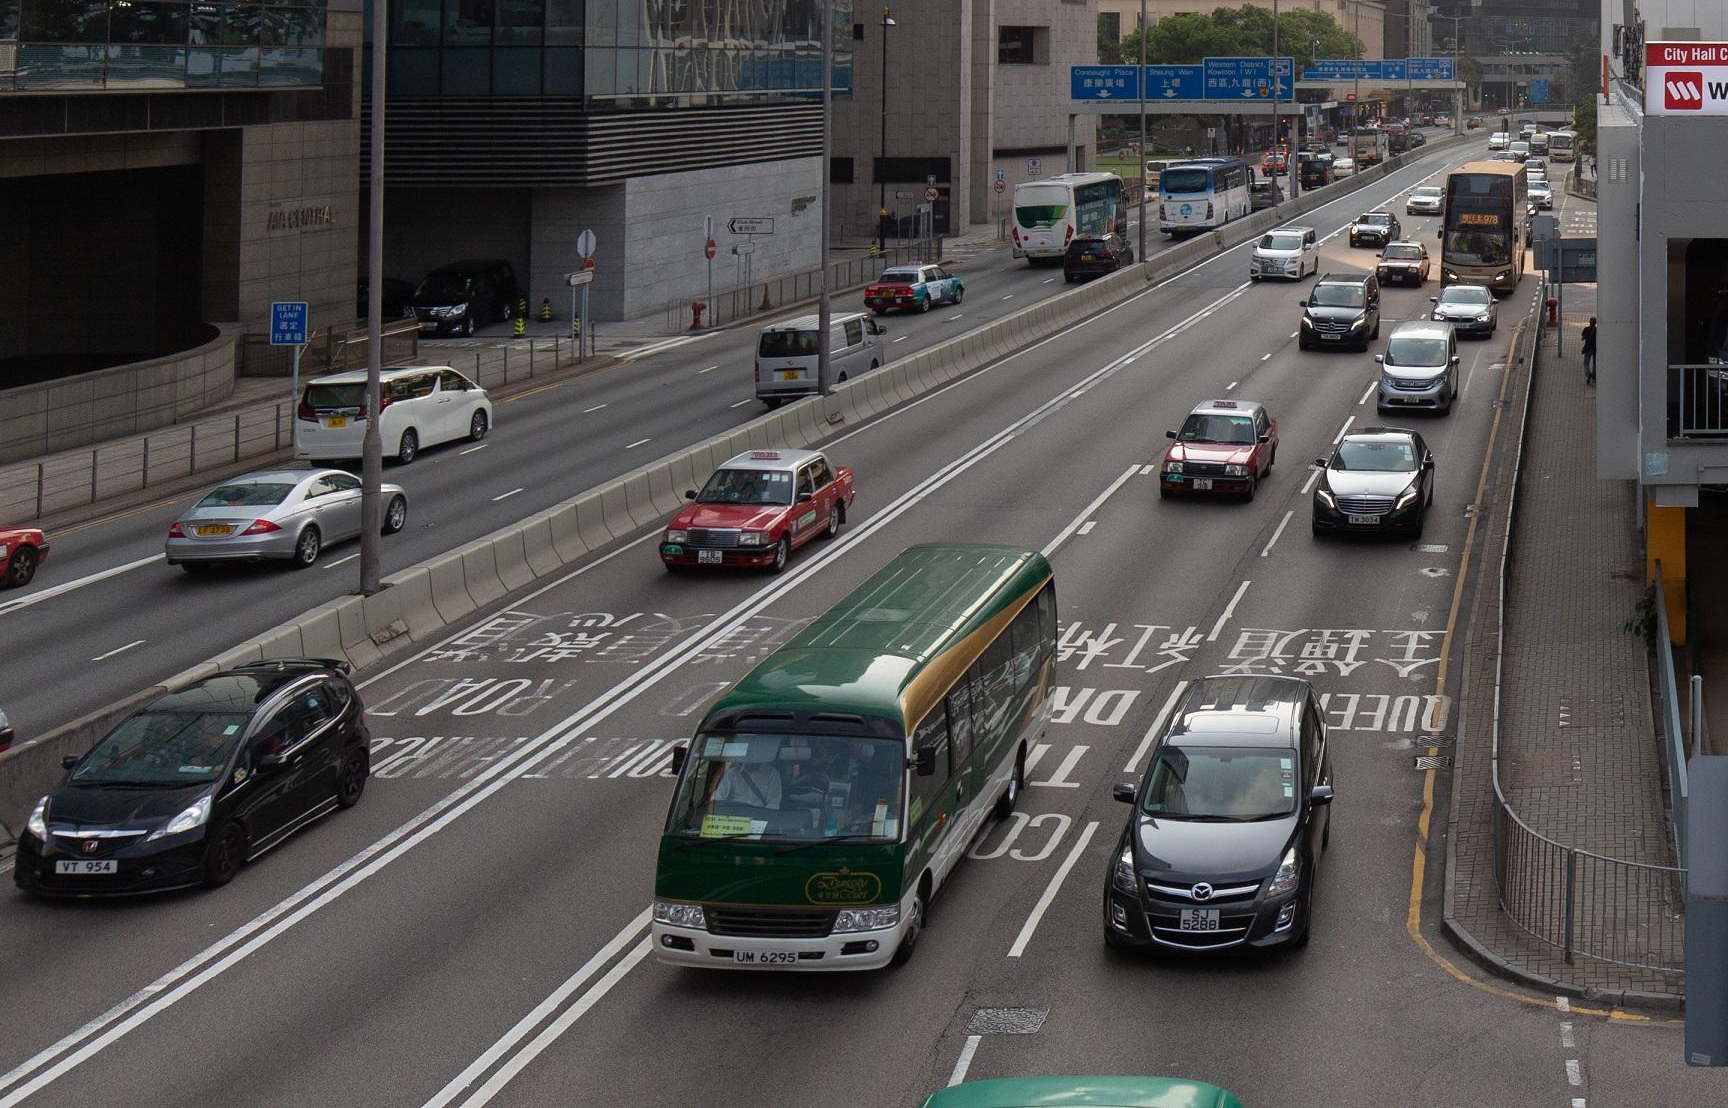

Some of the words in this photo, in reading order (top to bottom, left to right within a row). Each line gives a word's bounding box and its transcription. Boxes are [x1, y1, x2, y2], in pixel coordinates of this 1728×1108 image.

[1664, 47, 1688, 64] City
[1692, 47, 1716, 61] Hall
[1114, 68, 1134, 76] Place
[1149, 68, 1174, 77] Sheung
[277, 304, 291, 312] GET
[293, 304, 302, 312] IN
[1327, 693, 1452, 733] QUEE
[63, 862, 78, 872] VT
[86, 862, 111, 872] 954
[1192, 909, 1209, 920] SJ
[736, 951, 755, 963] UM
[760, 952, 796, 963] 6295
